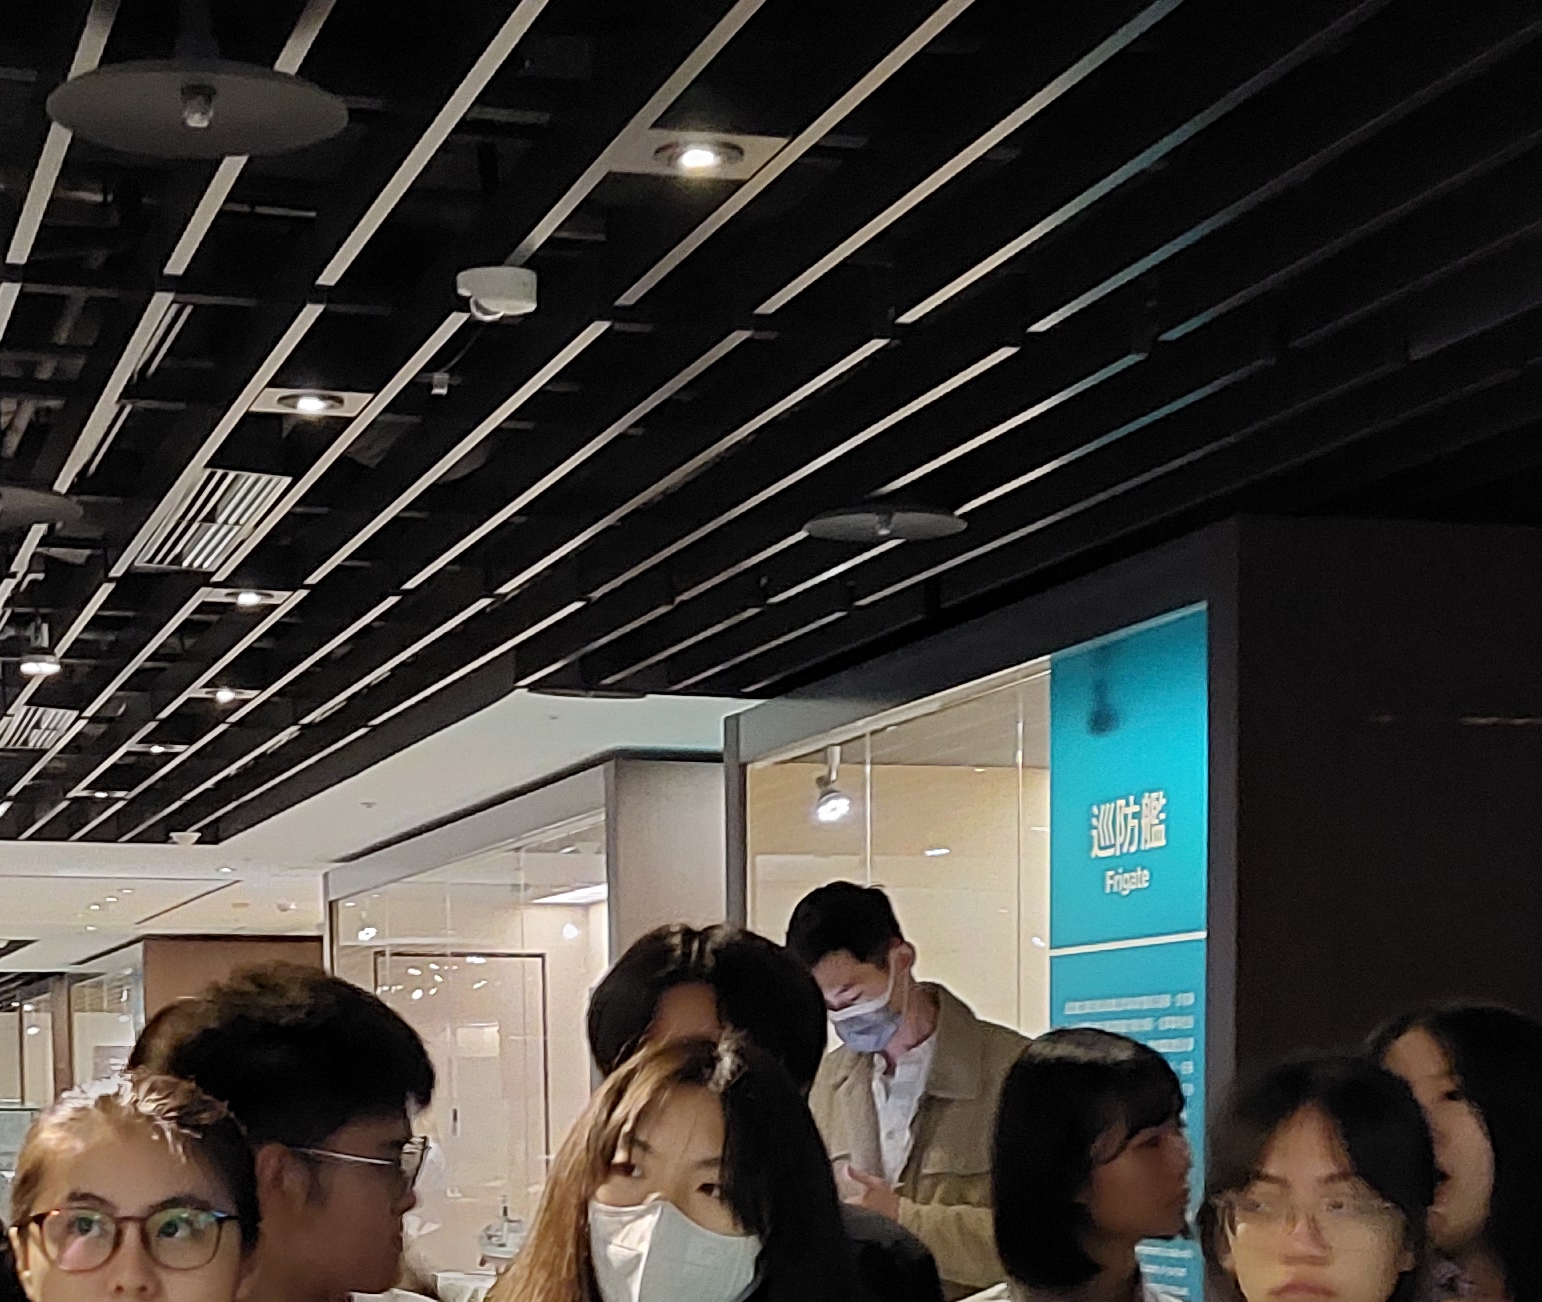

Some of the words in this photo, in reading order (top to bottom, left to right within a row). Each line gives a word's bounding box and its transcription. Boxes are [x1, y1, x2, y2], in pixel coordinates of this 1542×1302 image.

[1090, 791, 1167, 858] 巡防艦
[1104, 867, 1151, 895] Frigate
